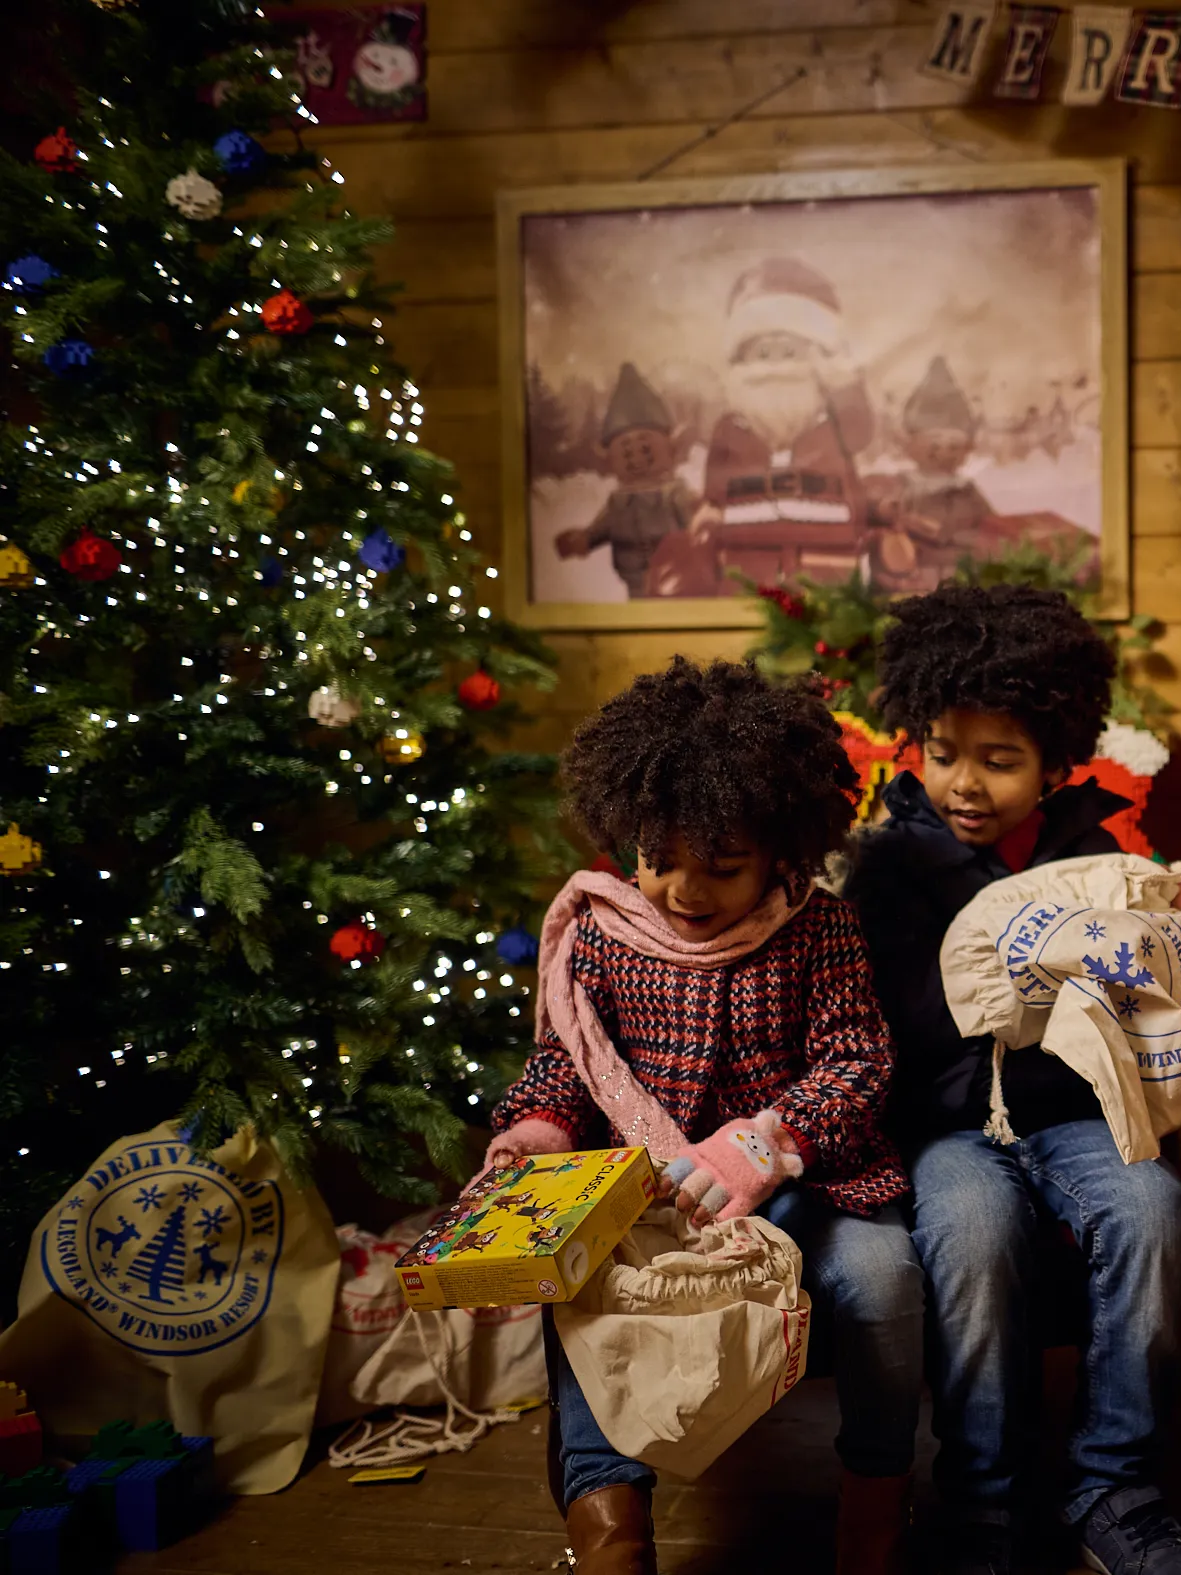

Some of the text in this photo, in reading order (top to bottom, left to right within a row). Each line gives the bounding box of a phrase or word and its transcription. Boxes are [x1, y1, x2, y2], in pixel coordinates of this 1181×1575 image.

[1007, 907, 1064, 996] LIVER
[576, 1165, 614, 1201] CLASSIC
[250, 1201, 274, 1236] BY
[406, 1277, 420, 1285] LEGO
[119, 1311, 218, 1341] WINDSOR
[222, 1273, 260, 1327] RESORT
